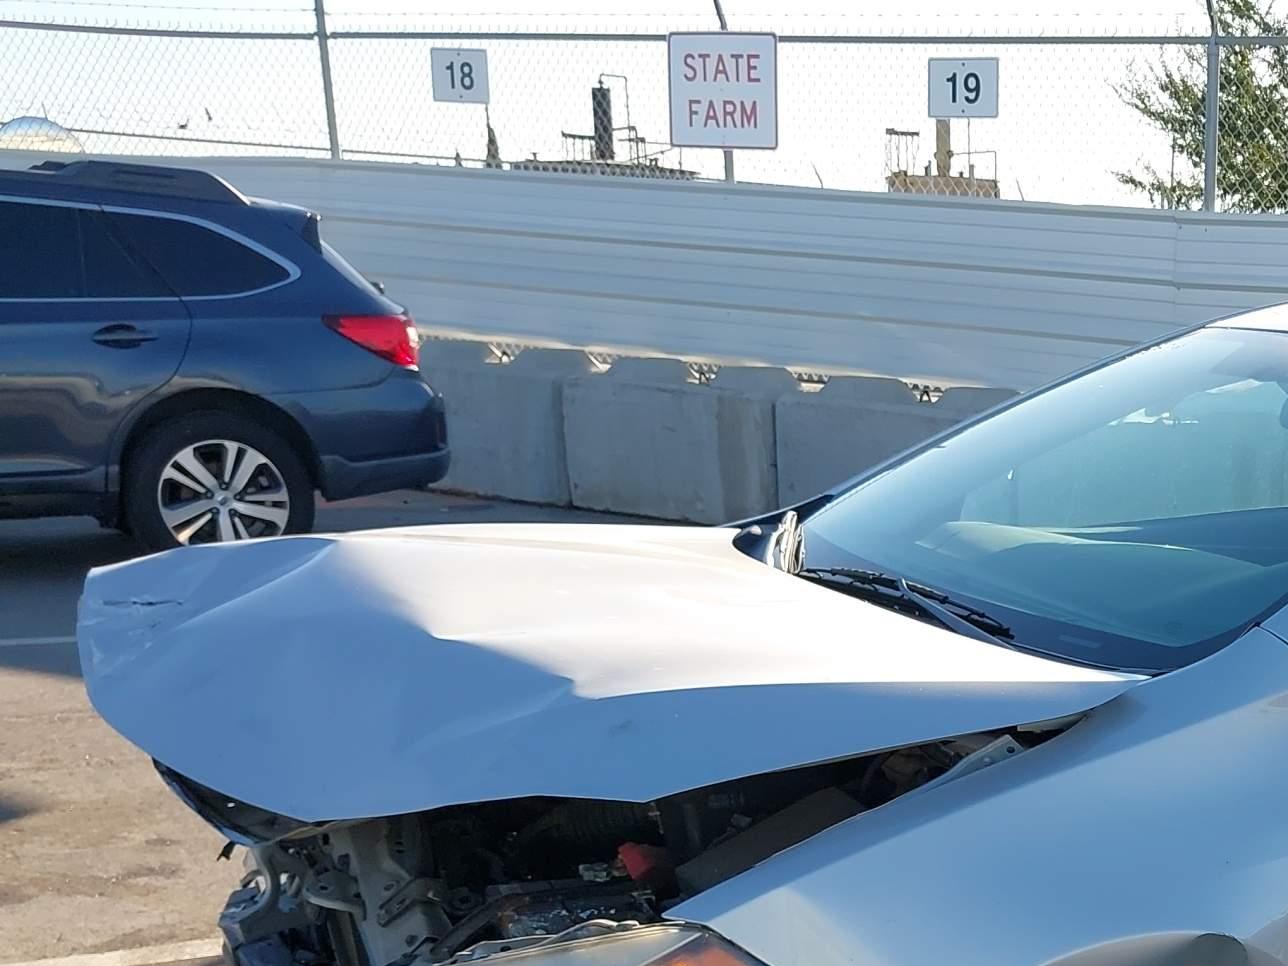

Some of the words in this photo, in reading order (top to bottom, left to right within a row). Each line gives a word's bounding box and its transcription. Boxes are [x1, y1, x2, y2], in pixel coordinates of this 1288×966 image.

[445, 61, 475, 90] 18
[683, 53, 761, 83] STATE
[946, 71, 981, 105] 19
[688, 99, 758, 129] FARM
